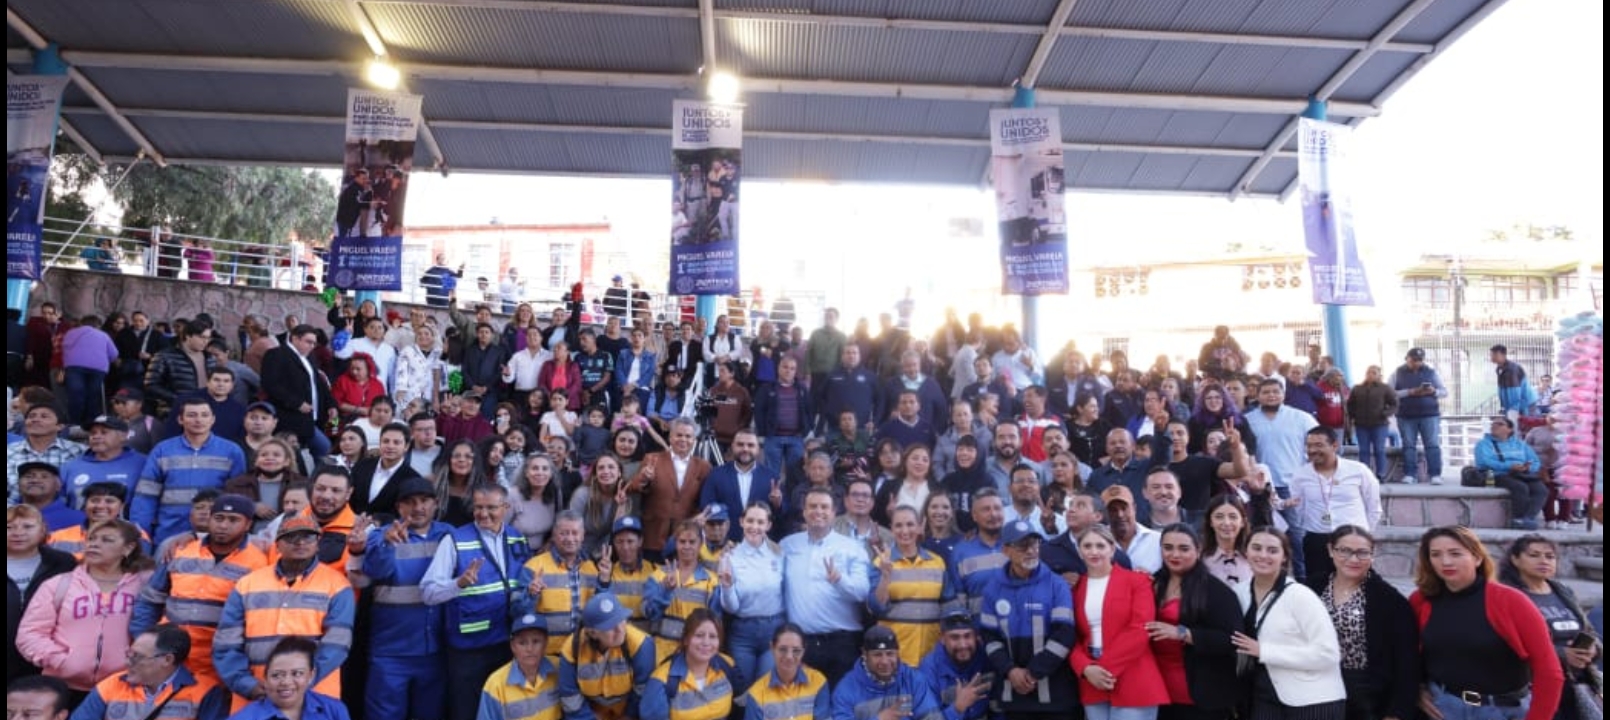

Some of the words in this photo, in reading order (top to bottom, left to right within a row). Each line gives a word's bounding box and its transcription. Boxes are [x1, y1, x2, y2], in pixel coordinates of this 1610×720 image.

[354, 94, 389, 106] JUNTOS
[353, 104, 396, 116] UNIDOS
[682, 106, 724, 118] JUNTOS
[682, 117, 731, 129] UNIDOS
[1001, 117, 1041, 129] JUNTOS
[1001, 126, 1050, 139] UNIDOS
[339, 245, 369, 254] MIGUEL
[370, 245, 397, 255] VARELA
[677, 252, 704, 262] MIGUEL
[705, 250, 734, 259] VARELA
